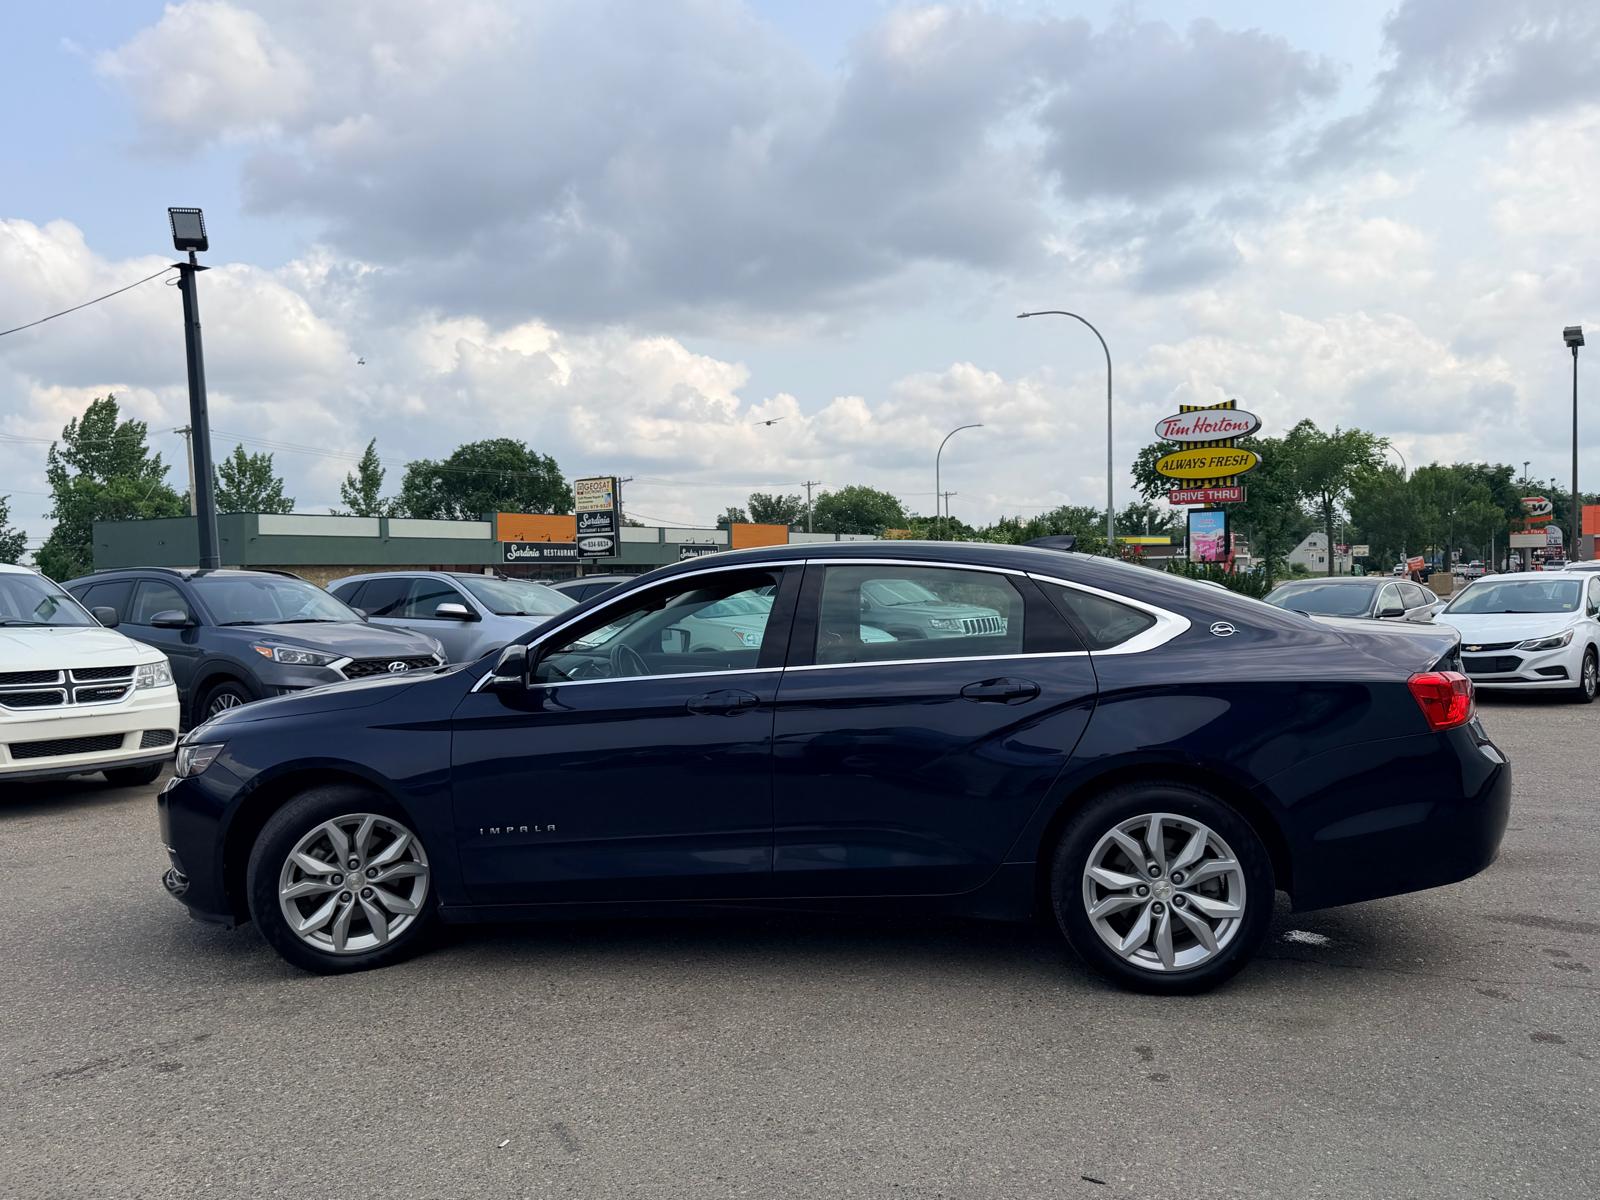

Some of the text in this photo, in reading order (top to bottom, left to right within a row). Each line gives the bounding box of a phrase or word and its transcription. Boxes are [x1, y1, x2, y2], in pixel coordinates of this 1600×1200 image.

[1163, 416, 1249, 437] Tim Hortons
[1161, 454, 1249, 471] ALWAYS FRESH
[584, 481, 610, 491] GEOSAT
[1172, 489, 1238, 502] DRIVE THRU
[580, 513, 610, 528] Sardinia
[506, 544, 577, 560] Sardinia RESTAURANT
[480, 824, 556, 835] IMPALA
